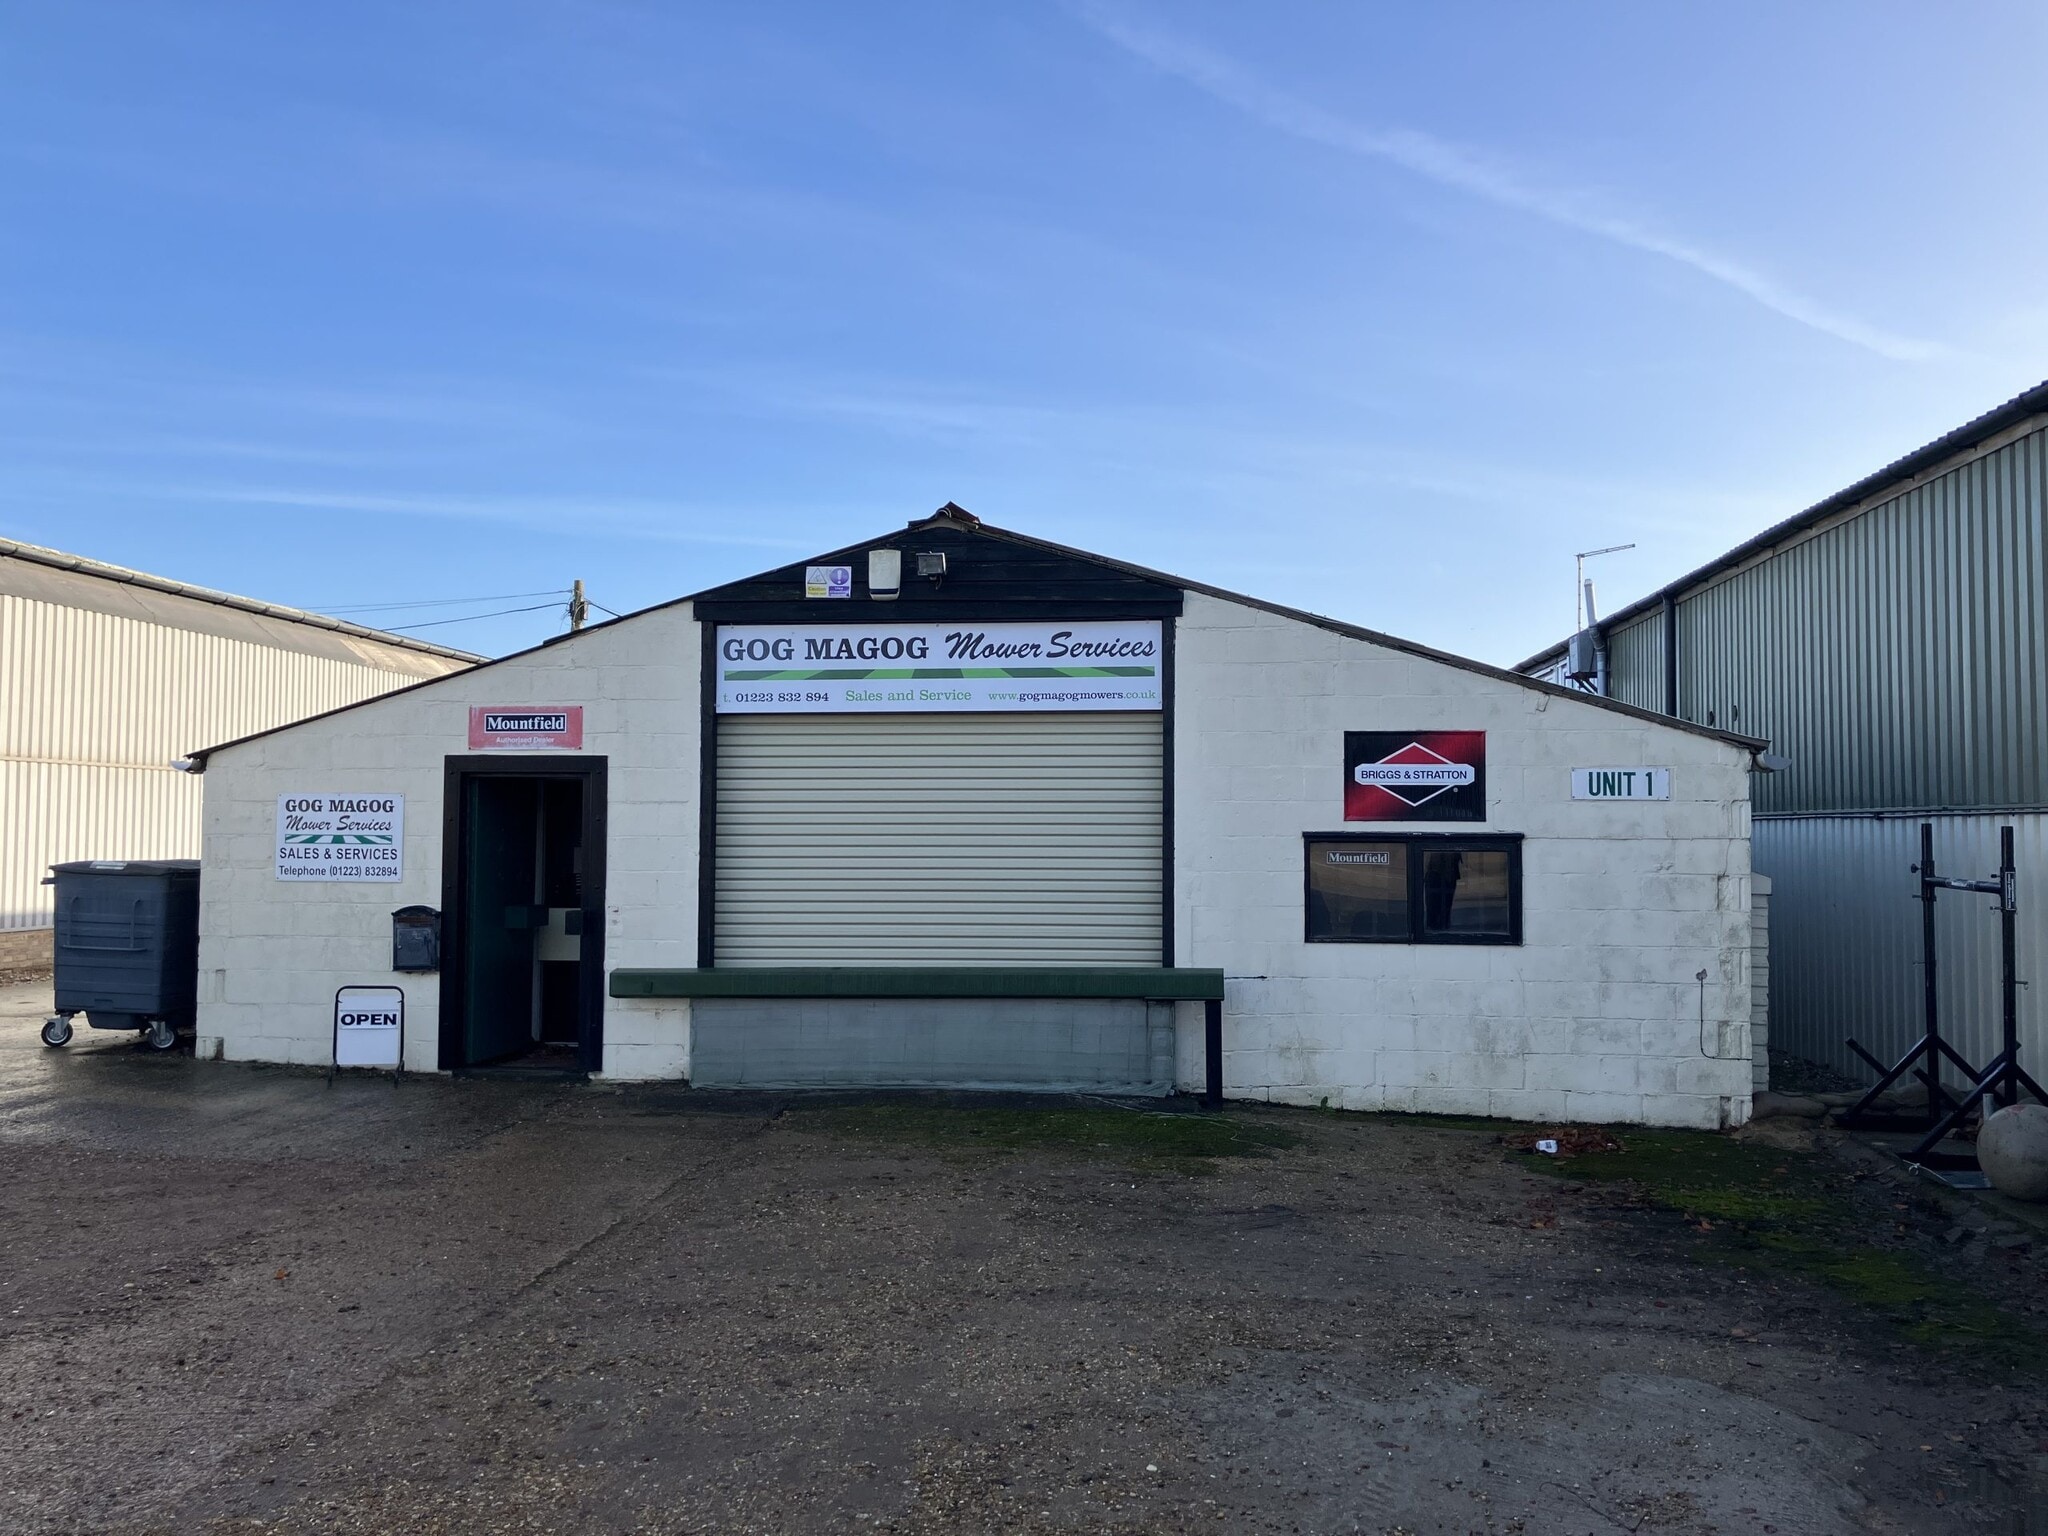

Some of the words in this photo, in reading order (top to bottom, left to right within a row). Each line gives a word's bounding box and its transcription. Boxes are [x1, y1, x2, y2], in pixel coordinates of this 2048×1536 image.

[723, 638, 795, 661] GOG
[804, 637, 929, 660] MAGOG
[945, 631, 1042, 660] Mower
[1046, 631, 1156, 659] Services
[735, 692, 773, 703] 01223
[778, 692, 801, 703] 832
[805, 692, 829, 703] 894
[845, 689, 883, 702] Sales
[887, 689, 915, 701] and
[919, 688, 972, 701] Service
[988, 689, 1156, 703] www.gogmagogmowers.co.uk
[487, 716, 565, 730] Mountfield
[1361, 770, 1401, 779] BRIGGS
[1403, 770, 1411, 779] &
[1413, 770, 1467, 779] STRATTON
[1588, 771, 1636, 796] UNIT
[1645, 771, 1652, 796] 1
[285, 799, 323, 813] GOG
[329, 799, 395, 813] MAGOG
[286, 815, 332, 831] Mower
[336, 815, 392, 831] Services
[280, 847, 319, 860] SALES
[324, 848, 332, 860] &
[336, 848, 398, 860] SERVICES
[1328, 852, 1388, 863] Mountfield
[279, 865, 326, 878] Telephone
[330, 865, 361, 878] (01223)
[365, 866, 398, 877] 832894
[341, 1013, 397, 1026] OPEN
